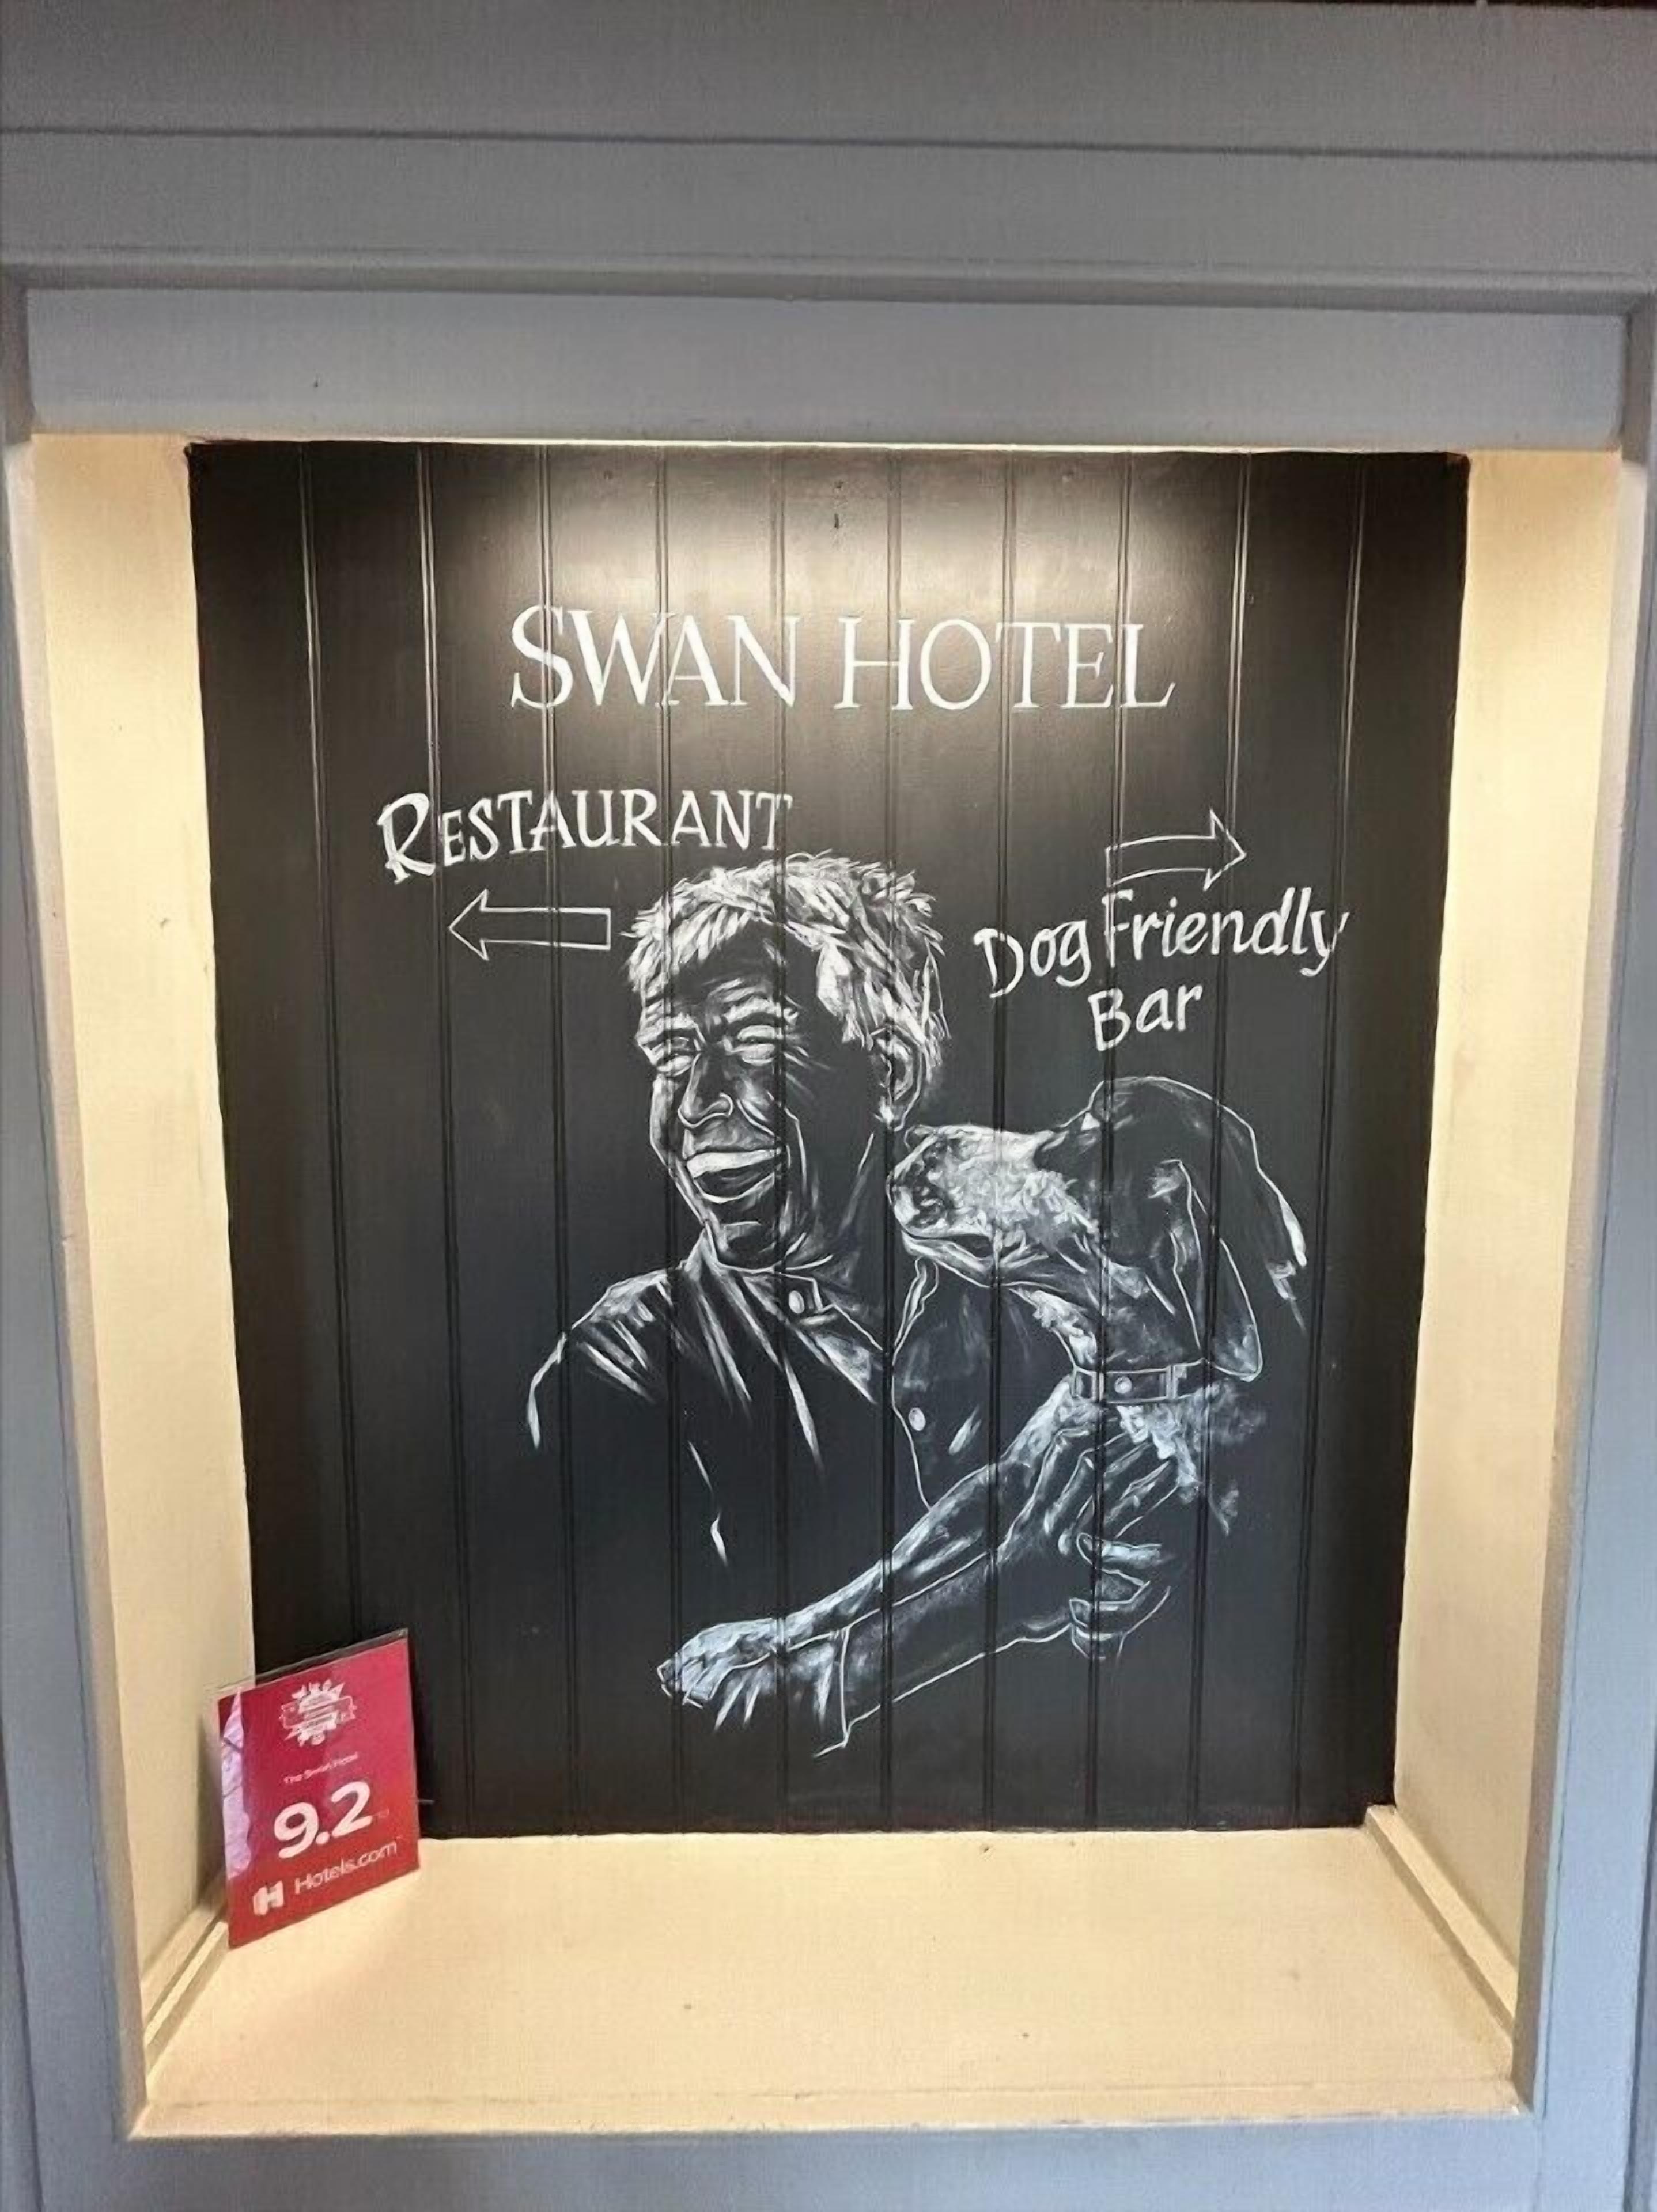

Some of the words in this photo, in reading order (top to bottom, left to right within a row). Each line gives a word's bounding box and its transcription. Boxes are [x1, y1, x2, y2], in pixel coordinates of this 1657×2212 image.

[510, 604, 799, 710] SWAN
[833, 616, 1176, 711] HOTEL
[376, 789, 793, 884] RESTAURANT
[973, 920, 1092, 999] Dog
[1101, 887, 1350, 977] Friendly
[1088, 984, 1204, 1051] Bar
[274, 1781, 373, 1859] 9.2
[294, 1841, 398, 1895] Hotels.com
